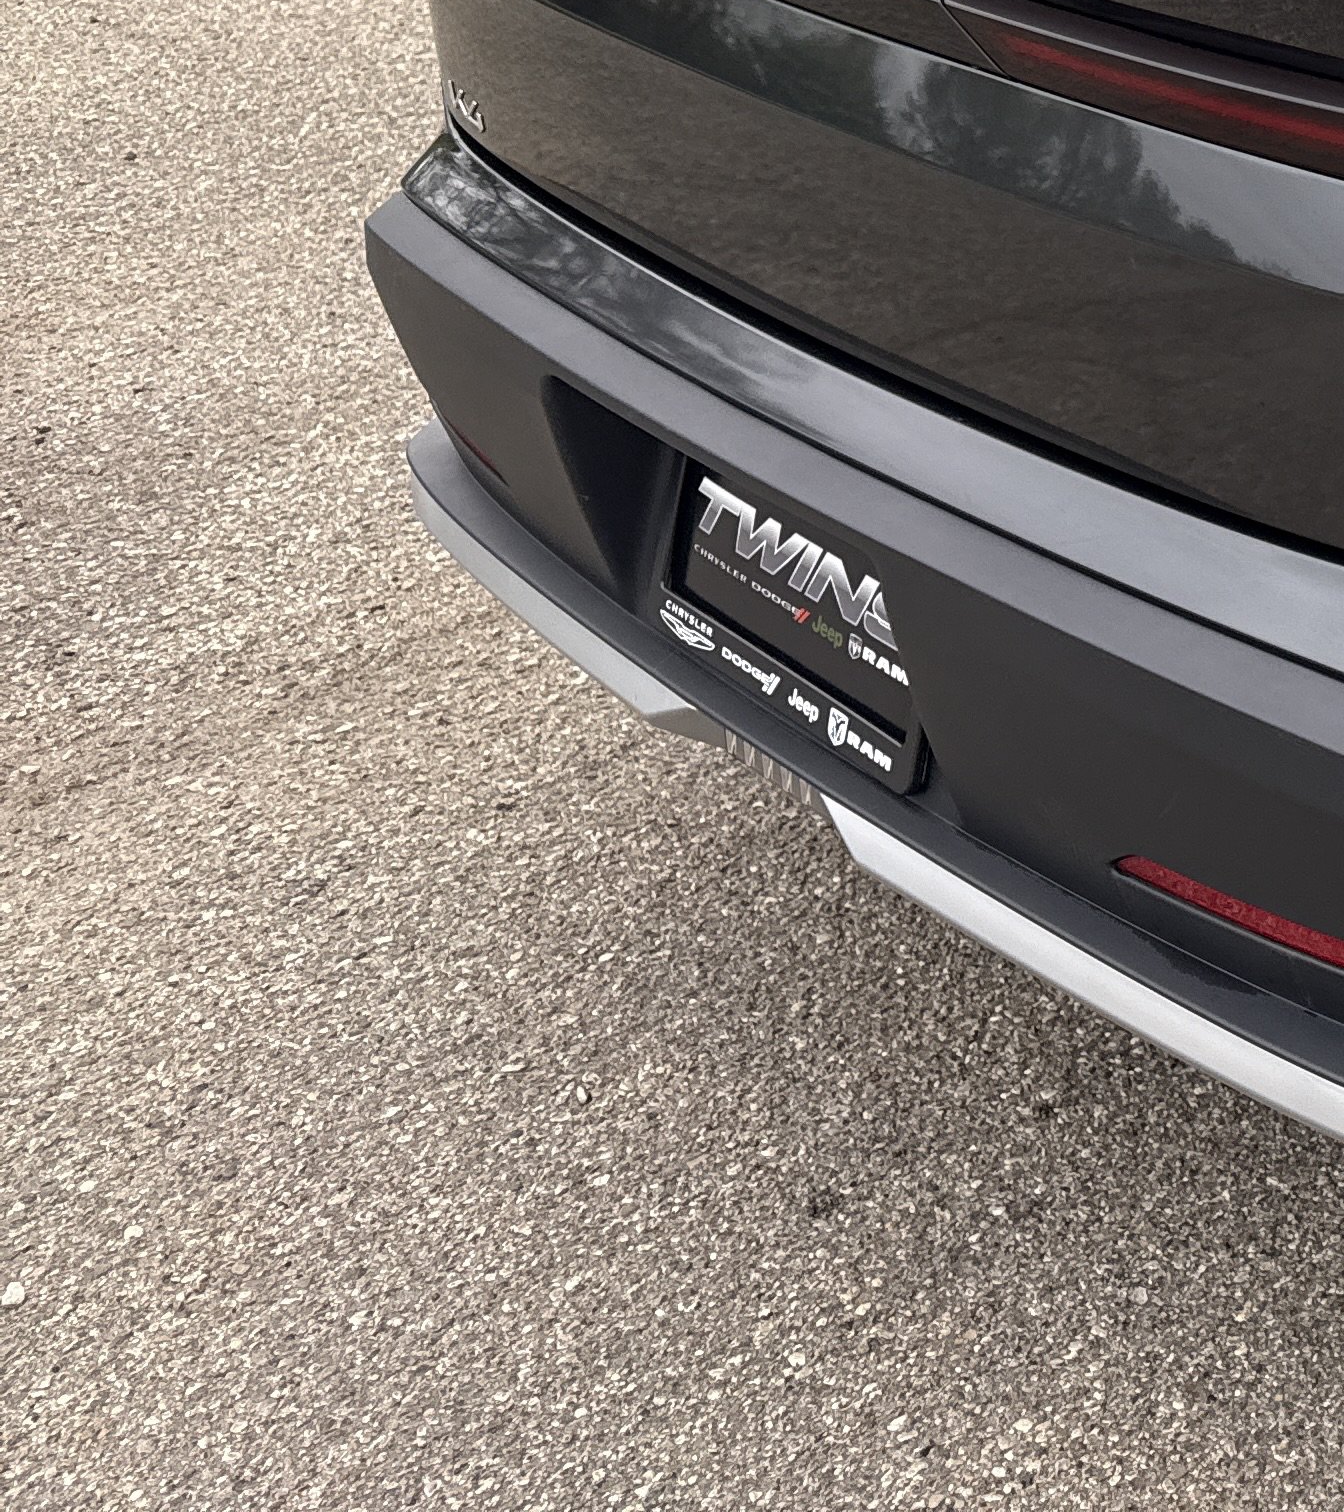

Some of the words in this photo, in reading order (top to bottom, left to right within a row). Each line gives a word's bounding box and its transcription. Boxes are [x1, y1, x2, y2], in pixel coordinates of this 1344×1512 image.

[665, 600, 713, 637] CHRYSLER
[721, 646, 772, 684] DODGE
[788, 688, 819, 723] Jeep
[847, 730, 892, 772] RAM
[694, 544, 748, 583] CHRYSLER
[751, 581, 801, 616] DODGE
[811, 616, 844, 649] Jeep
[862, 646, 909, 686] RAM
